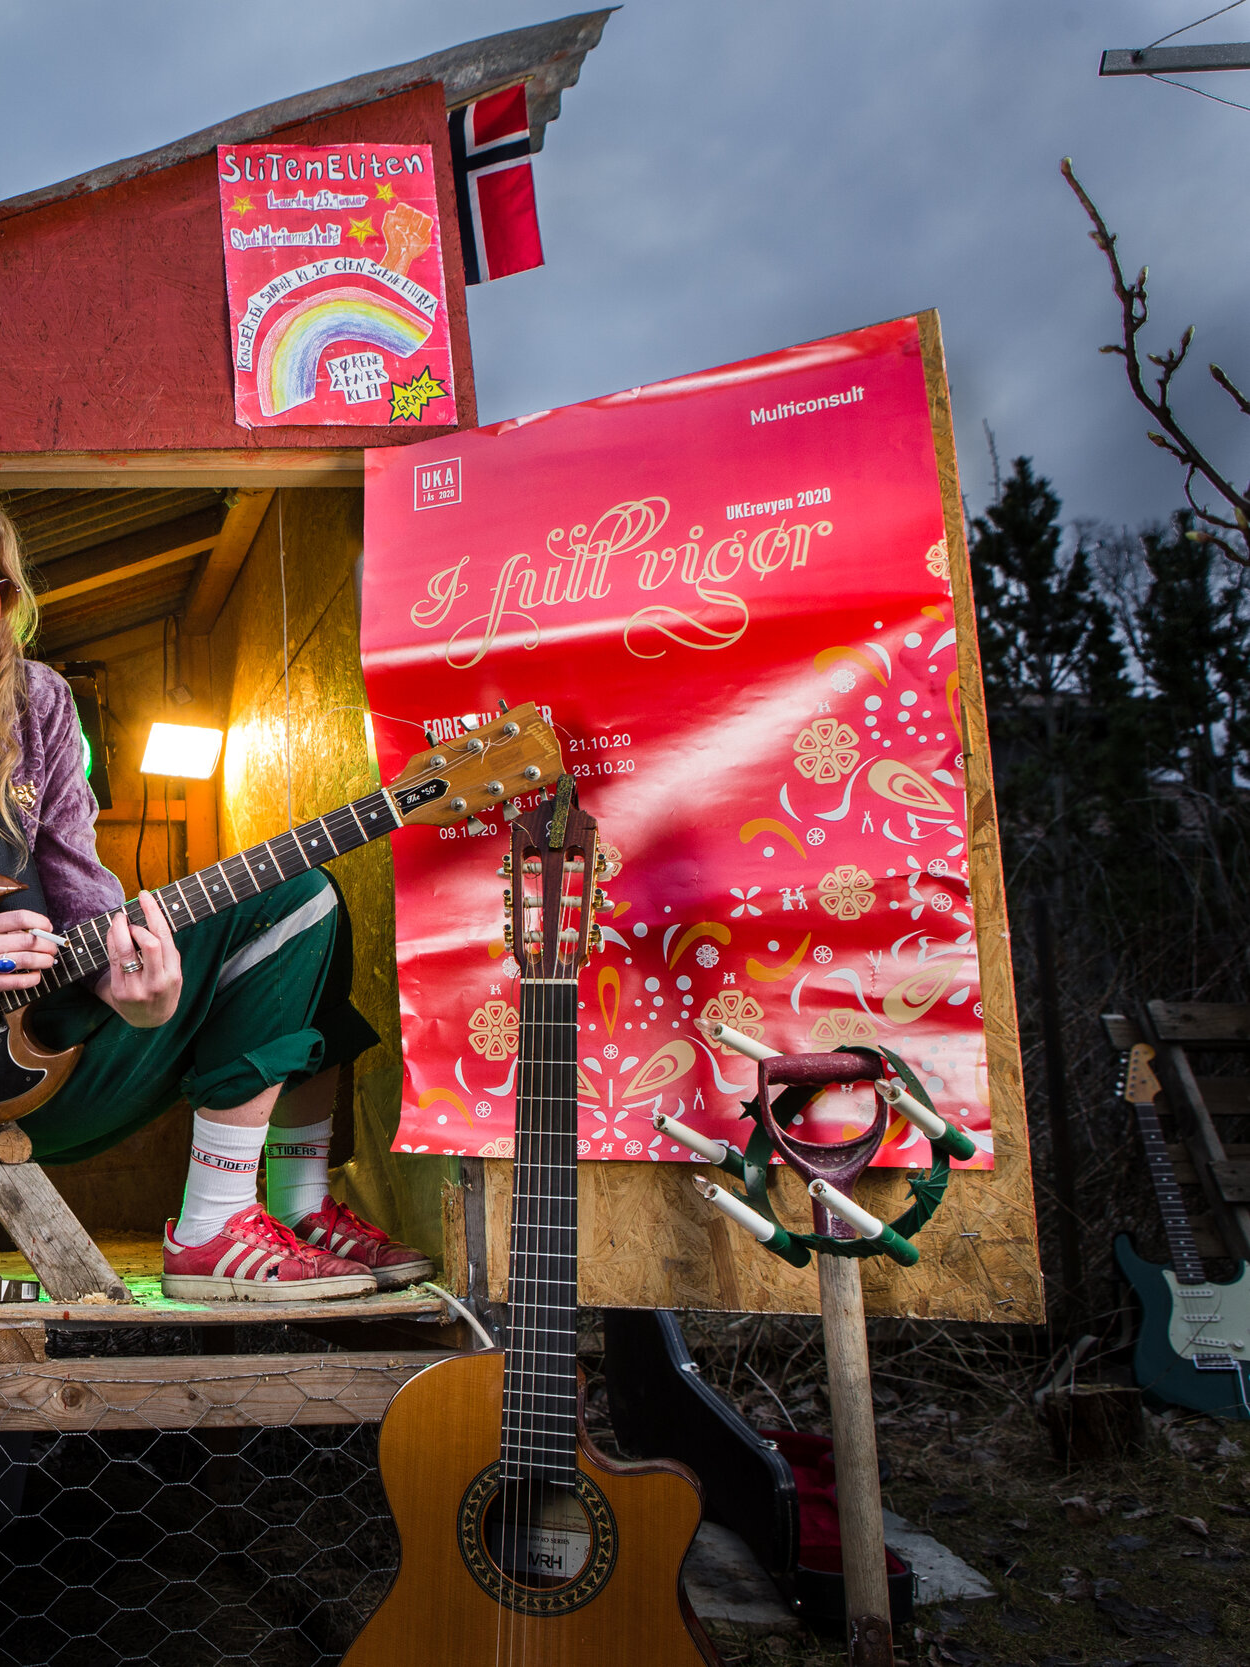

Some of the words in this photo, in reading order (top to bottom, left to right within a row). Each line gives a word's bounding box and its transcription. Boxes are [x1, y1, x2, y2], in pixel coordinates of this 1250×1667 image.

[327, 352, 382, 374] DØRENE
[333, 368, 387, 389] ÅPNER
[396, 381, 434, 412] GRATIS
[750, 385, 865, 426] Multiconsult
[422, 467, 454, 490] UKA
[438, 489, 455, 500] 2020
[726, 497, 793, 520] UKErevyen
[797, 487, 832, 507] 2020
[524, 721, 558, 760] Gibson
[569, 733, 632, 752] 21.10.20
[572, 758, 636, 778] 23.10.20
